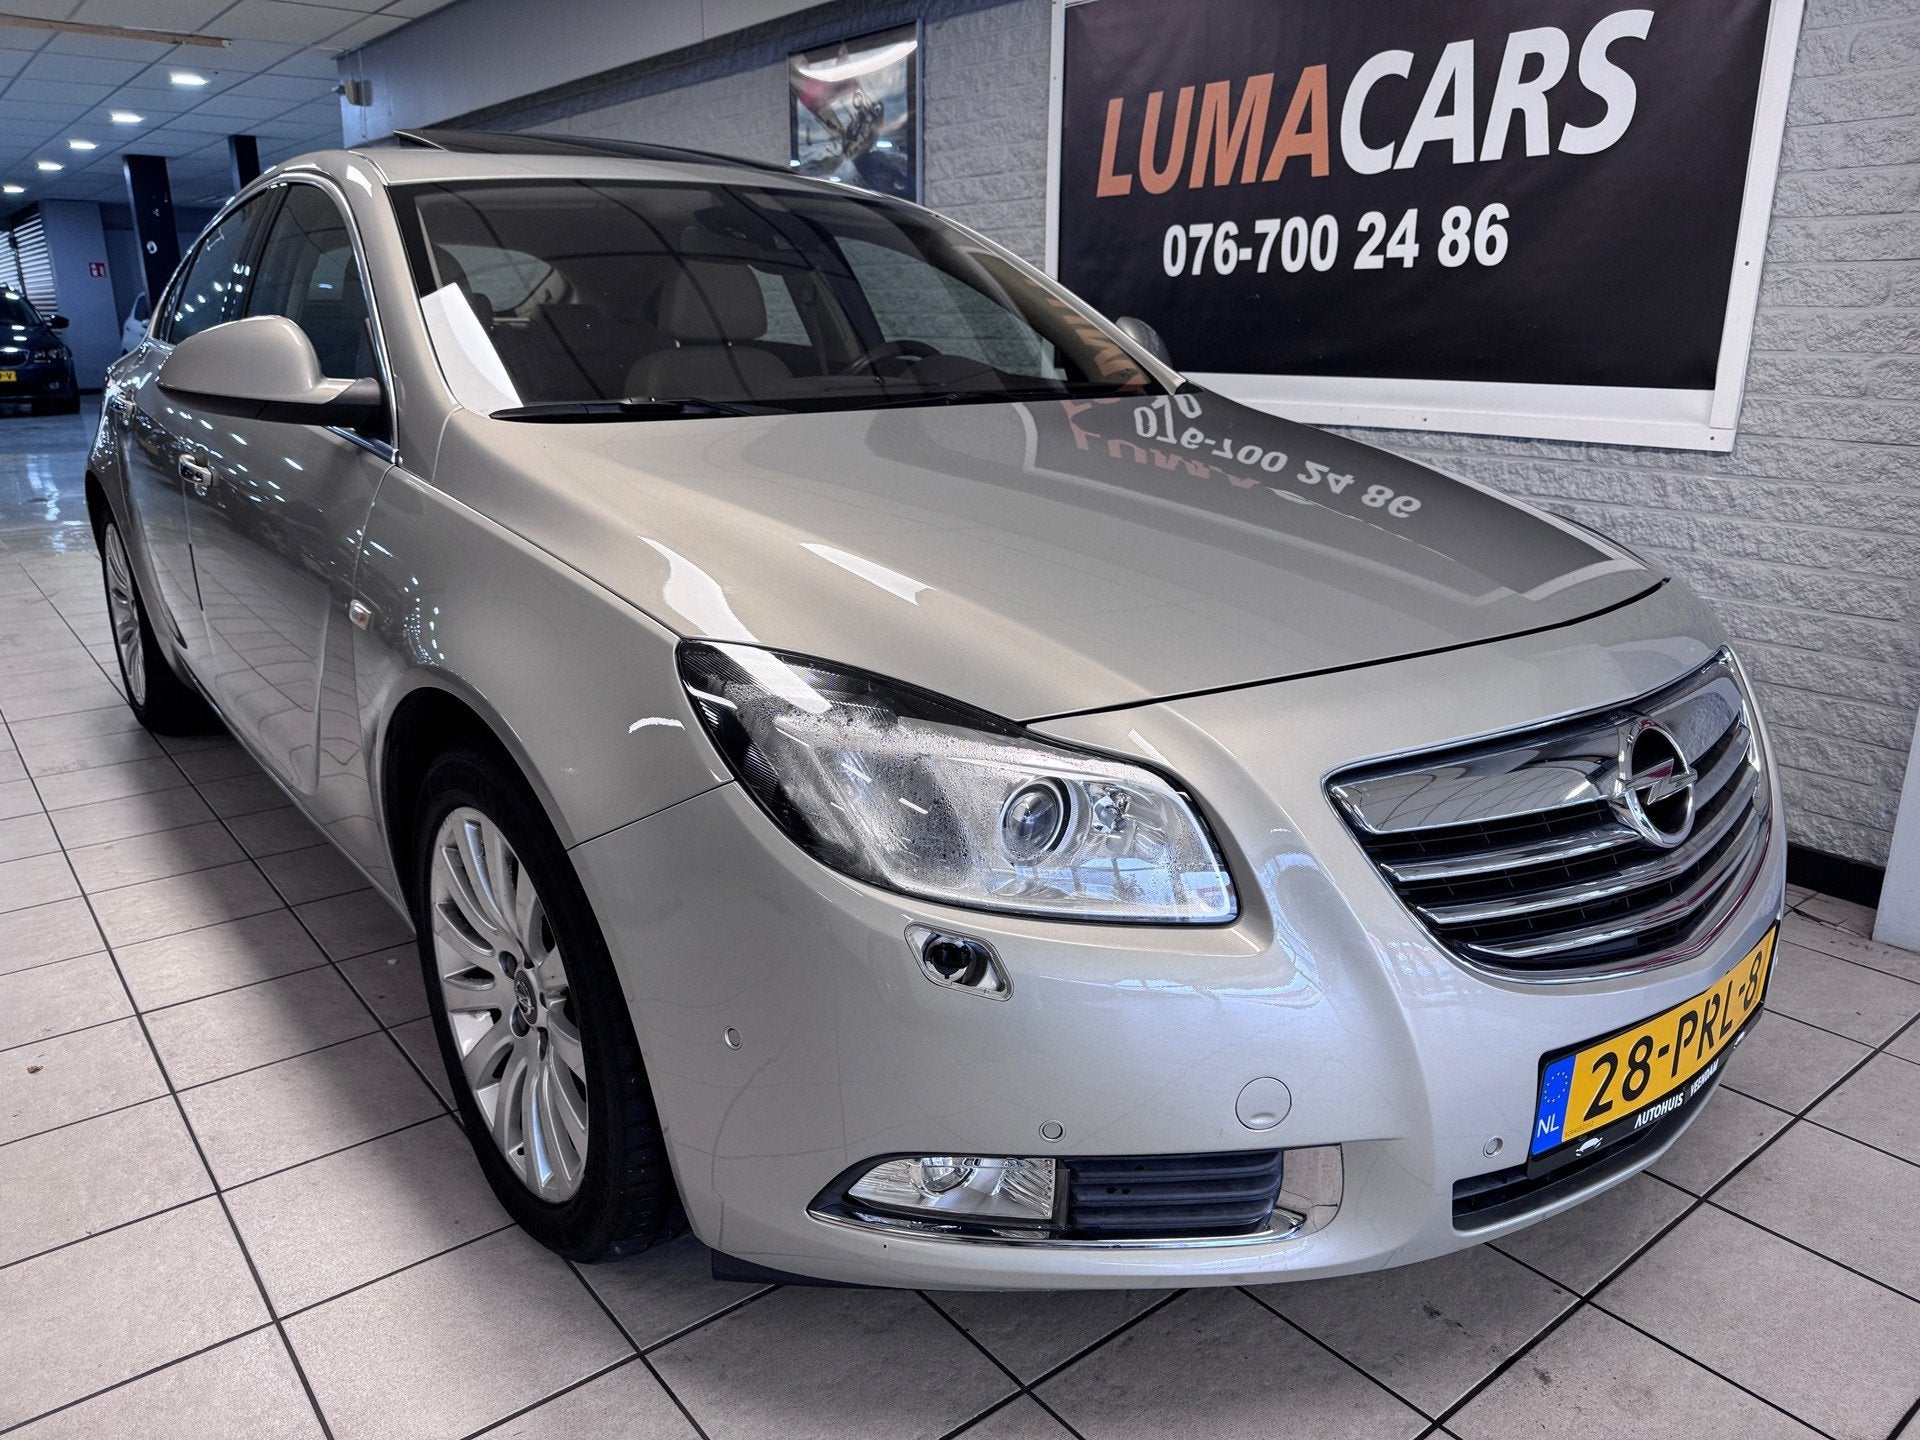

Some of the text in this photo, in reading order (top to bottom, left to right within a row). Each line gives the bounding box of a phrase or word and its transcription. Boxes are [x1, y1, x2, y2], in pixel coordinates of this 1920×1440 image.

[1162, 203, 1510, 277] 076-700 24 86
[1583, 951, 1763, 1122] 28-PRL-8
[1537, 1115, 1560, 1138] NL
[1634, 1092, 1684, 1129] AUTOHUIS
